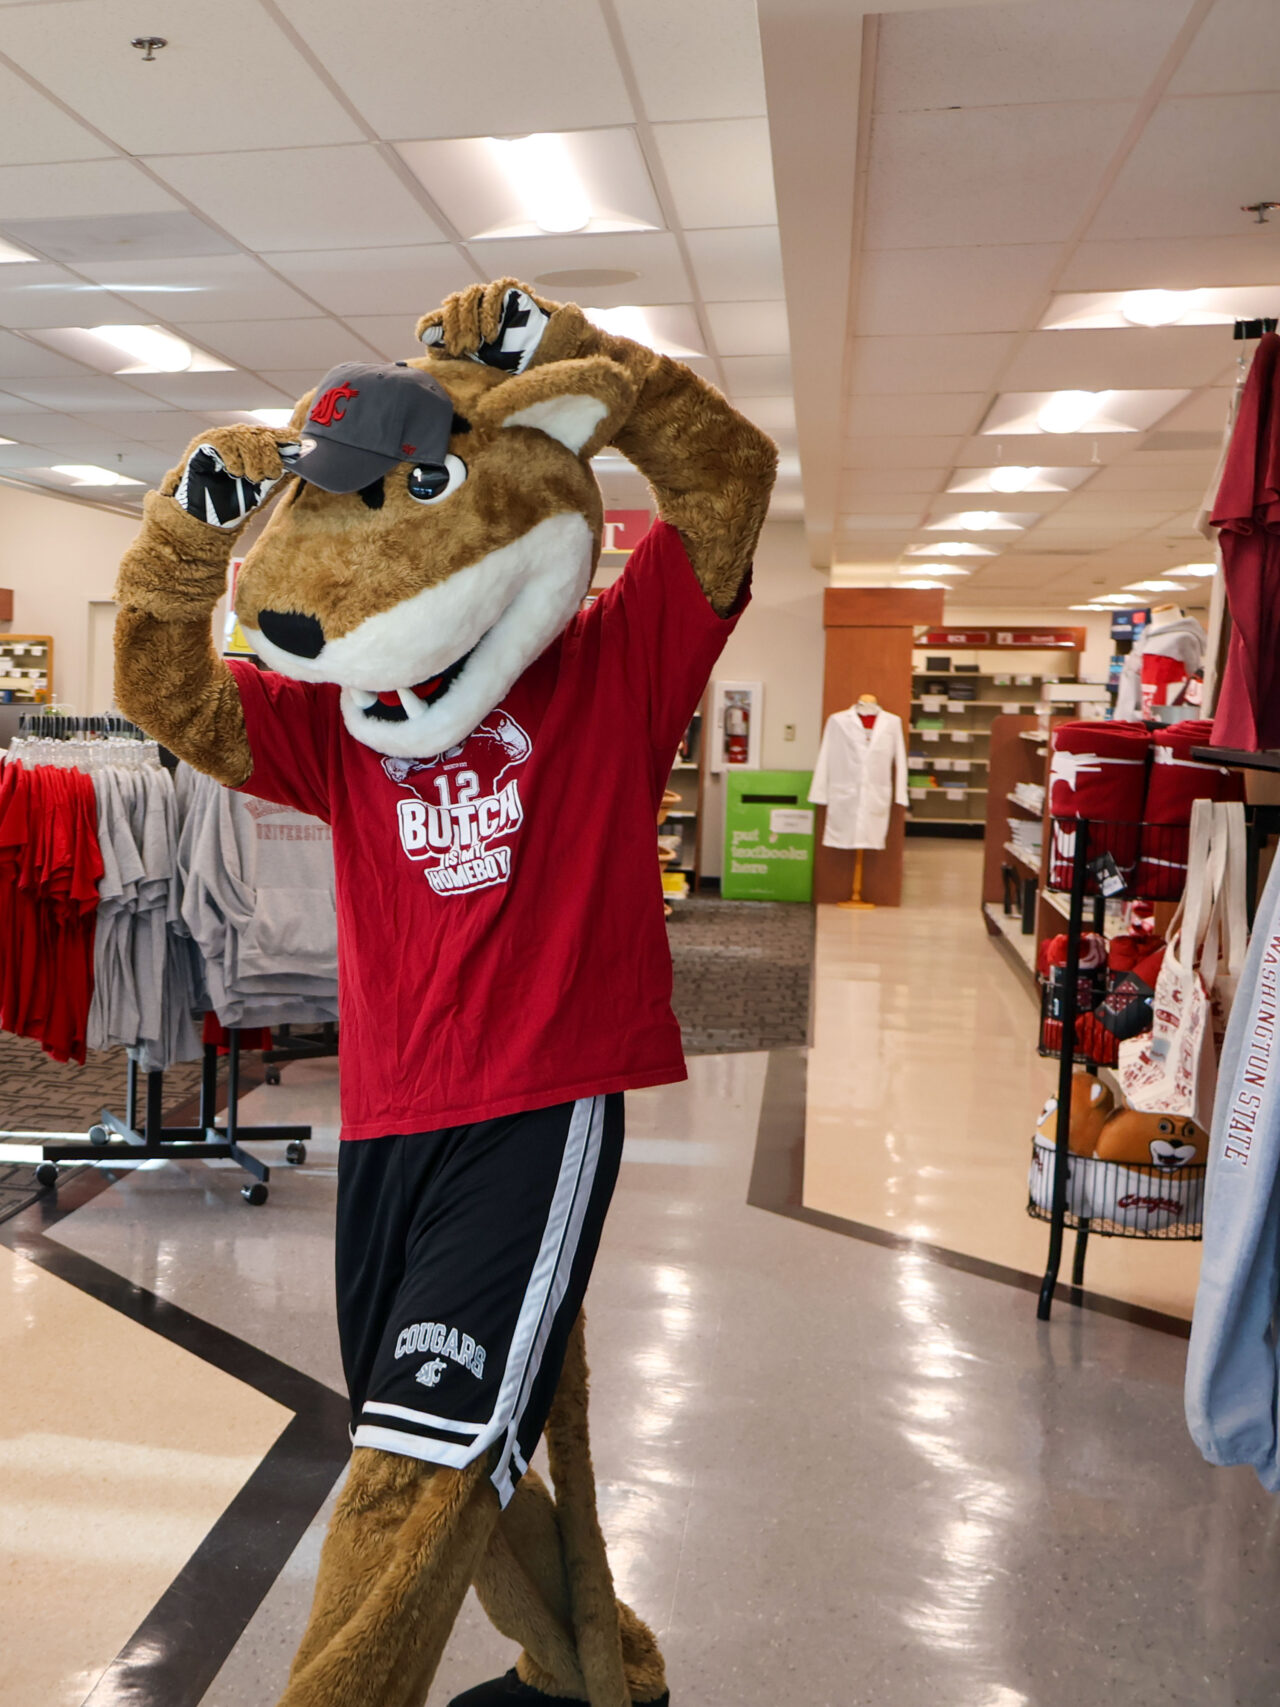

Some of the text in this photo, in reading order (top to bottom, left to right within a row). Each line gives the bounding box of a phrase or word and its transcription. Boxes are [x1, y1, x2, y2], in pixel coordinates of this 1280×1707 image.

[434, 770, 480, 806] 12
[400, 780, 520, 850] BUTCH
[429, 851, 507, 890] HOMEBOY
[445, 850, 458, 867] IS
[461, 843, 481, 862] MY
[731, 860, 768, 874] here
[732, 846, 808, 860] textbooks
[1224, 1090, 1261, 1166] STATE
[394, 1322, 486, 1380] COUGARS
